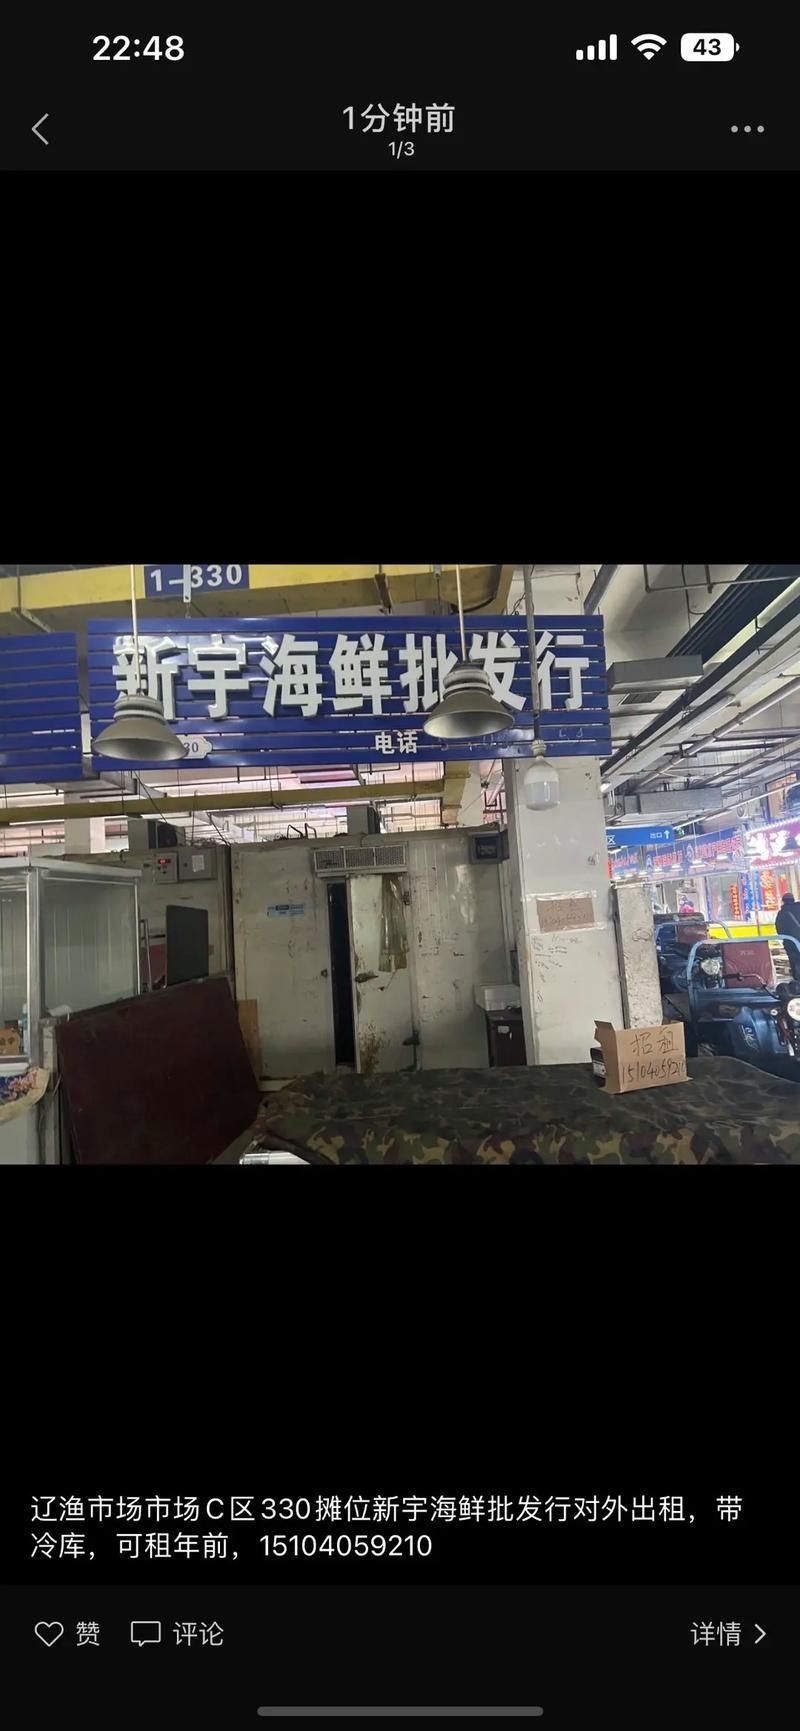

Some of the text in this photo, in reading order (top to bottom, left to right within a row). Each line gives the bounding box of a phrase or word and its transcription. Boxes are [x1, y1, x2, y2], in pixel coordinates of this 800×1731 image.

[150, 564, 242, 591] 1-330
[112, 631, 590, 721] 新宇海鲜批发行
[375, 731, 419, 755] 电话
[630, 1026, 680, 1056] 招租
